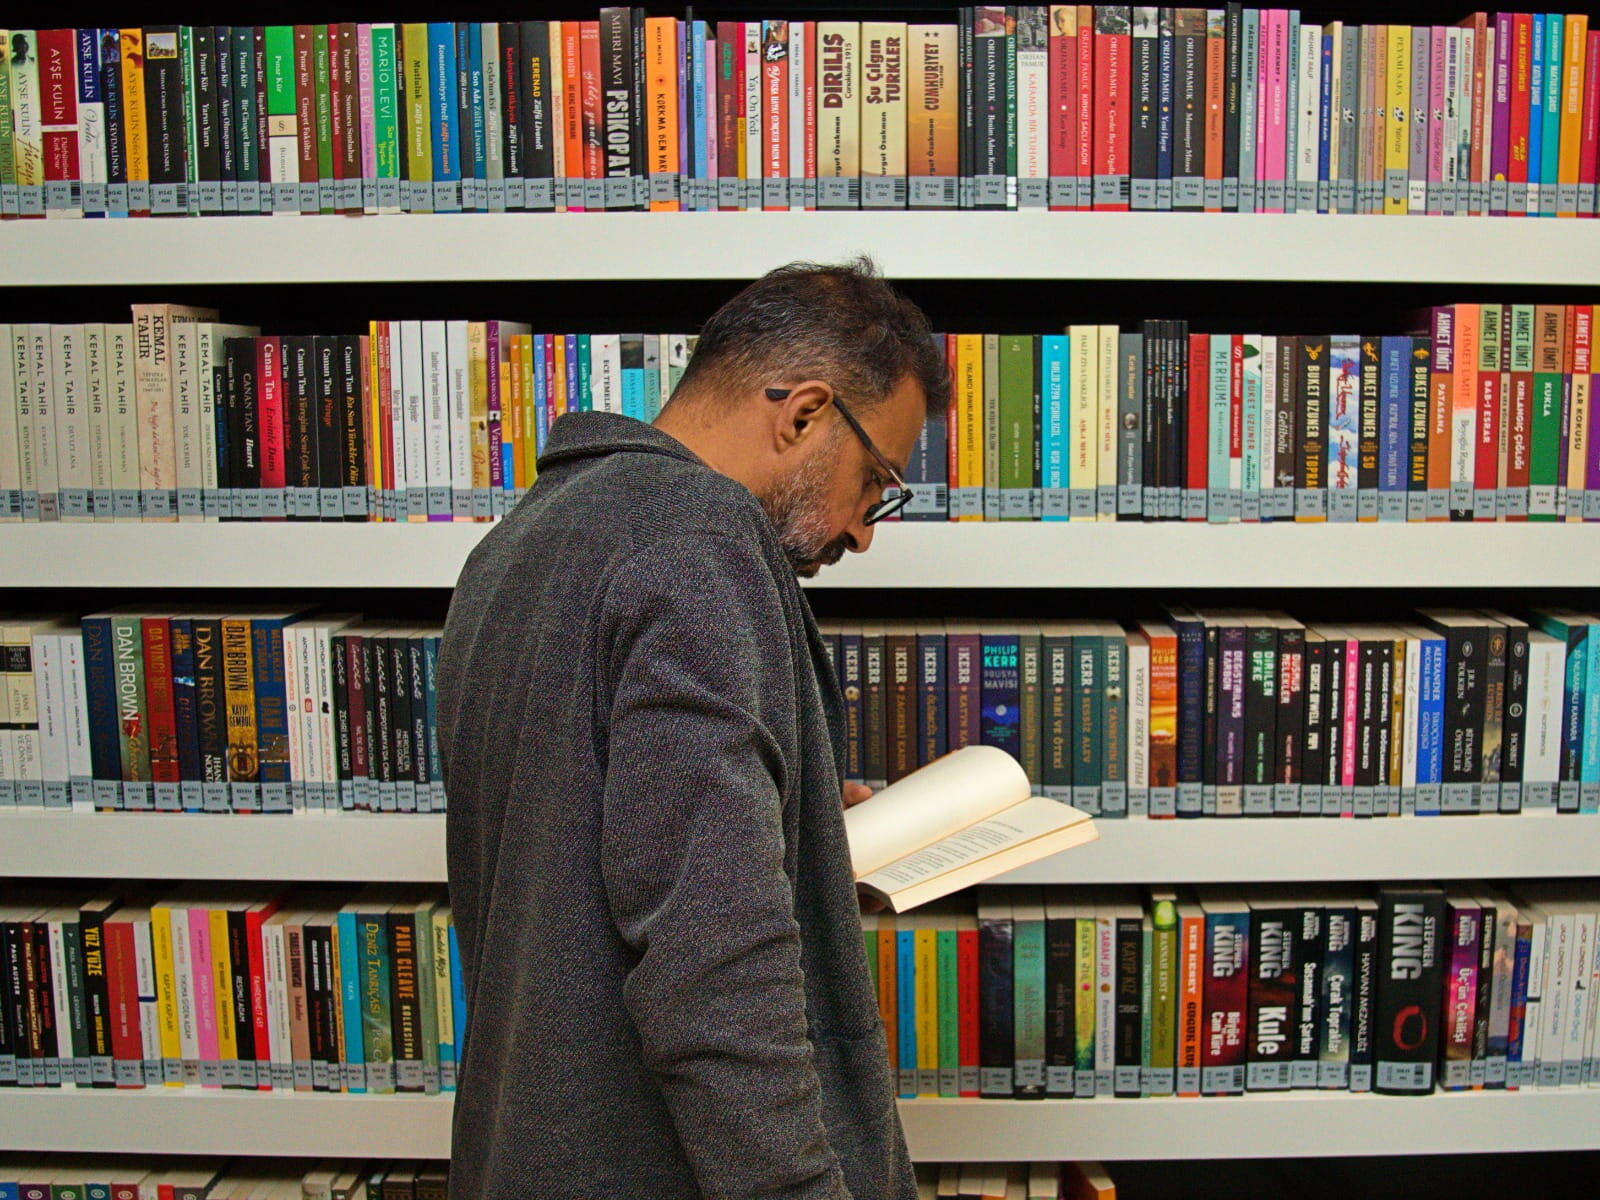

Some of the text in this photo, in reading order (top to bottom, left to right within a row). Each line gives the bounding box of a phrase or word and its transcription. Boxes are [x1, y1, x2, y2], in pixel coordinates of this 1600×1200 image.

[50, 48, 64, 120] AYŞE KULİN
[82, 34, 94, 98] AYŞE KULİN
[532, 57, 541, 97] SERENAD
[137, 315, 150, 359] TAHİR
[153, 315, 165, 365] KEMAL
[1437, 312, 1450, 344] AHMET
[1483, 310, 1497, 342] AHMET
[1516, 311, 1529, 342] AHMET
[1543, 312, 1559, 344] AHMET
[1576, 313, 1589, 346] AHMET
[17, 336, 28, 416] KEMAL TAHİR
[35, 336, 46, 416] KEMAL TAHİR
[64, 335, 74, 415] KEMAL TAHİR
[89, 334, 101, 414] KEMAL TAHİR
[116, 335, 126, 414] KEMAL TAHİR
[177, 335, 189, 414] KEMAL TAHİR
[201, 334, 211, 413] KEMAL TAHİR
[264, 344, 275, 400] Canan Tan
[298, 378, 306, 395] Tan
[324, 378, 332, 395] Tan
[346, 376, 354, 393] Tan
[1308, 365, 1319, 396] BUKET
[1364, 366, 1376, 396] BUKET
[1306, 400, 1319, 438] UZUNER
[1363, 400, 1376, 438] UZUNER
[1544, 382, 1552, 416] KUKLA
[1412, 367, 1426, 481] BUKET UZUNER HAVA
[1574, 408, 1583, 450] KOKUSU
[196, 627, 212, 669] DAN
[225, 626, 248, 691] DAN BROWN
[117, 627, 138, 720] DAN BROWN
[395, 926, 411, 953] PAUL
[1213, 925, 1235, 977] KING
[1260, 922, 1283, 978] KING
[1391, 904, 1424, 979] KING
[397, 958, 413, 999] CLEAVE
[1257, 1007, 1286, 1054] Kule
